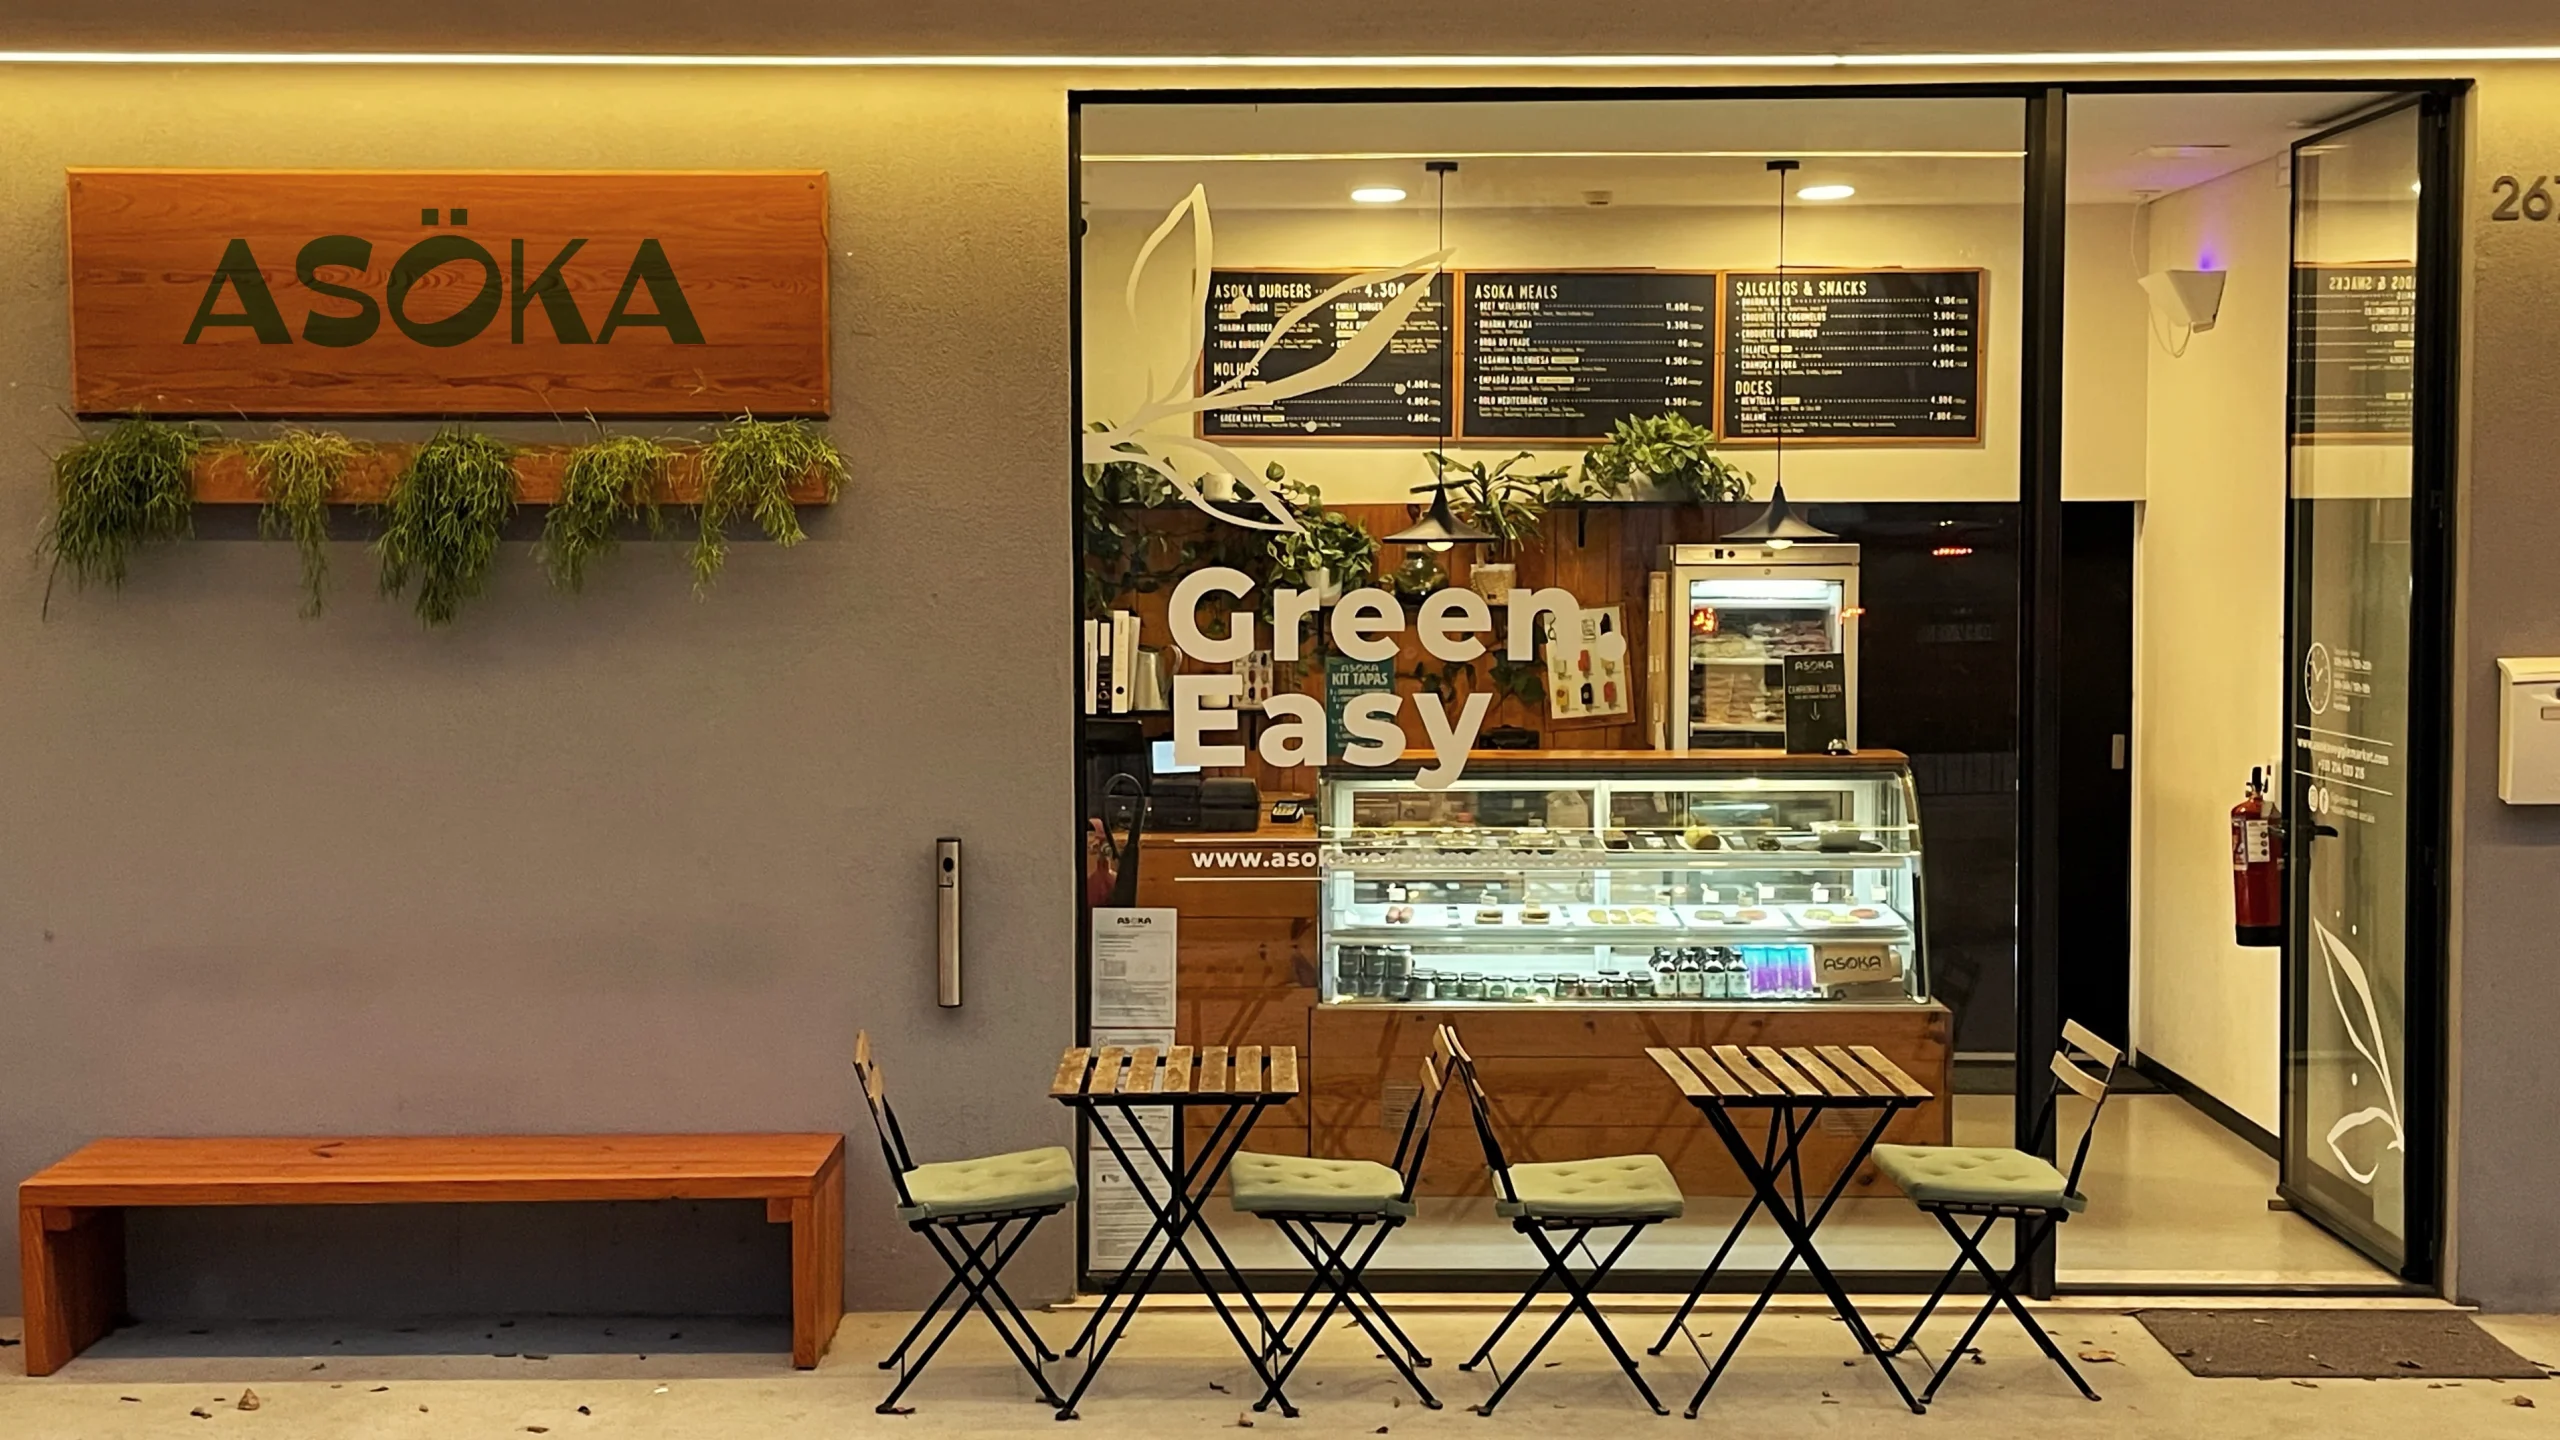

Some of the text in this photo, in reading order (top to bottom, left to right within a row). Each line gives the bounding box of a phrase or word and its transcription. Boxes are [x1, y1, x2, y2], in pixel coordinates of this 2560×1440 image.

[2492, 175, 2560, 221] 26
[183, 208, 706, 347] ASÖKA
[1215, 284, 1253, 298] ASOKA
[1259, 283, 1312, 298] BURGERS
[1474, 284, 1558, 299] ASOKA MEALS
[1736, 281, 1867, 296] SALGADOS & SNACKS
[1247, 323, 1273, 332] BURGER
[1735, 380, 1773, 395] DOCES
[1794, 660, 1834, 671] ASOKA
[1331, 673, 1389, 685] KIT TAPAS
[1173, 674, 1493, 790] Easy
[1823, 955, 1882, 970] ASOKA
